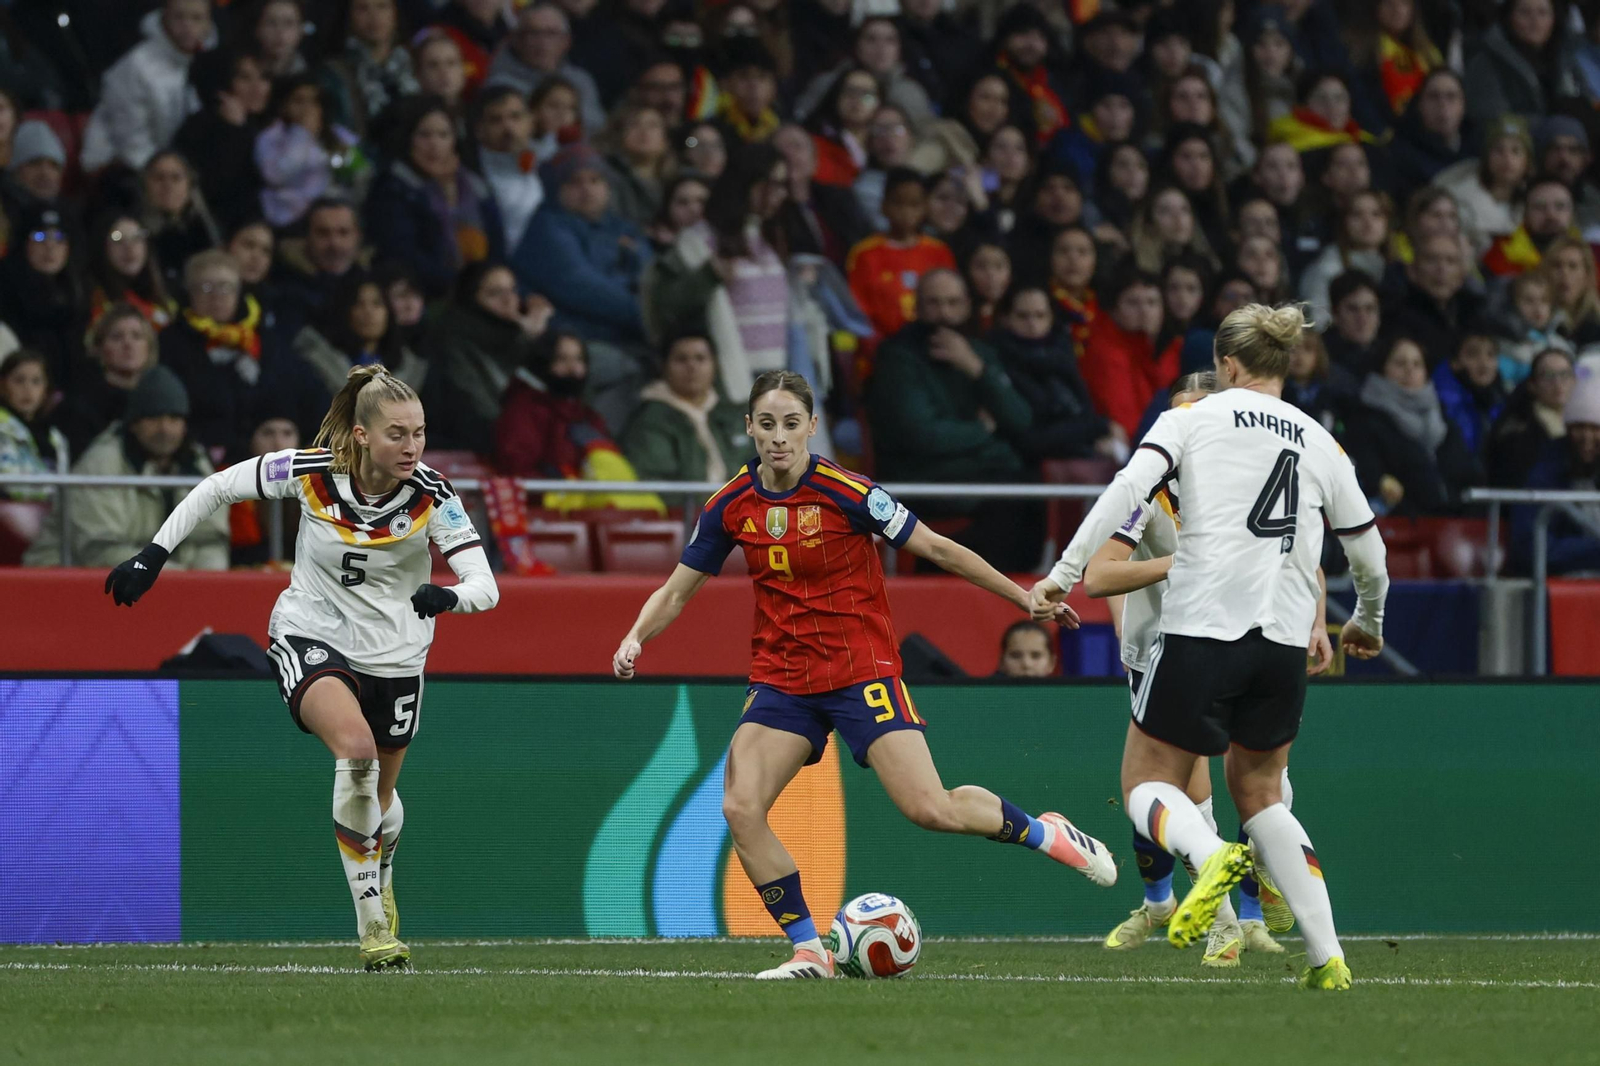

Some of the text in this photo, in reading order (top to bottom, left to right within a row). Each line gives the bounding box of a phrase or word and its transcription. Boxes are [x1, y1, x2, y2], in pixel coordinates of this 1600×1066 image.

[1233, 409, 1306, 449] KNAAK
[1246, 448, 1300, 555] 4
[341, 551, 368, 587] 5
[768, 545, 794, 581] 9
[389, 693, 416, 736] 5
[863, 682, 895, 724] 9
[358, 871, 377, 881] DFB
